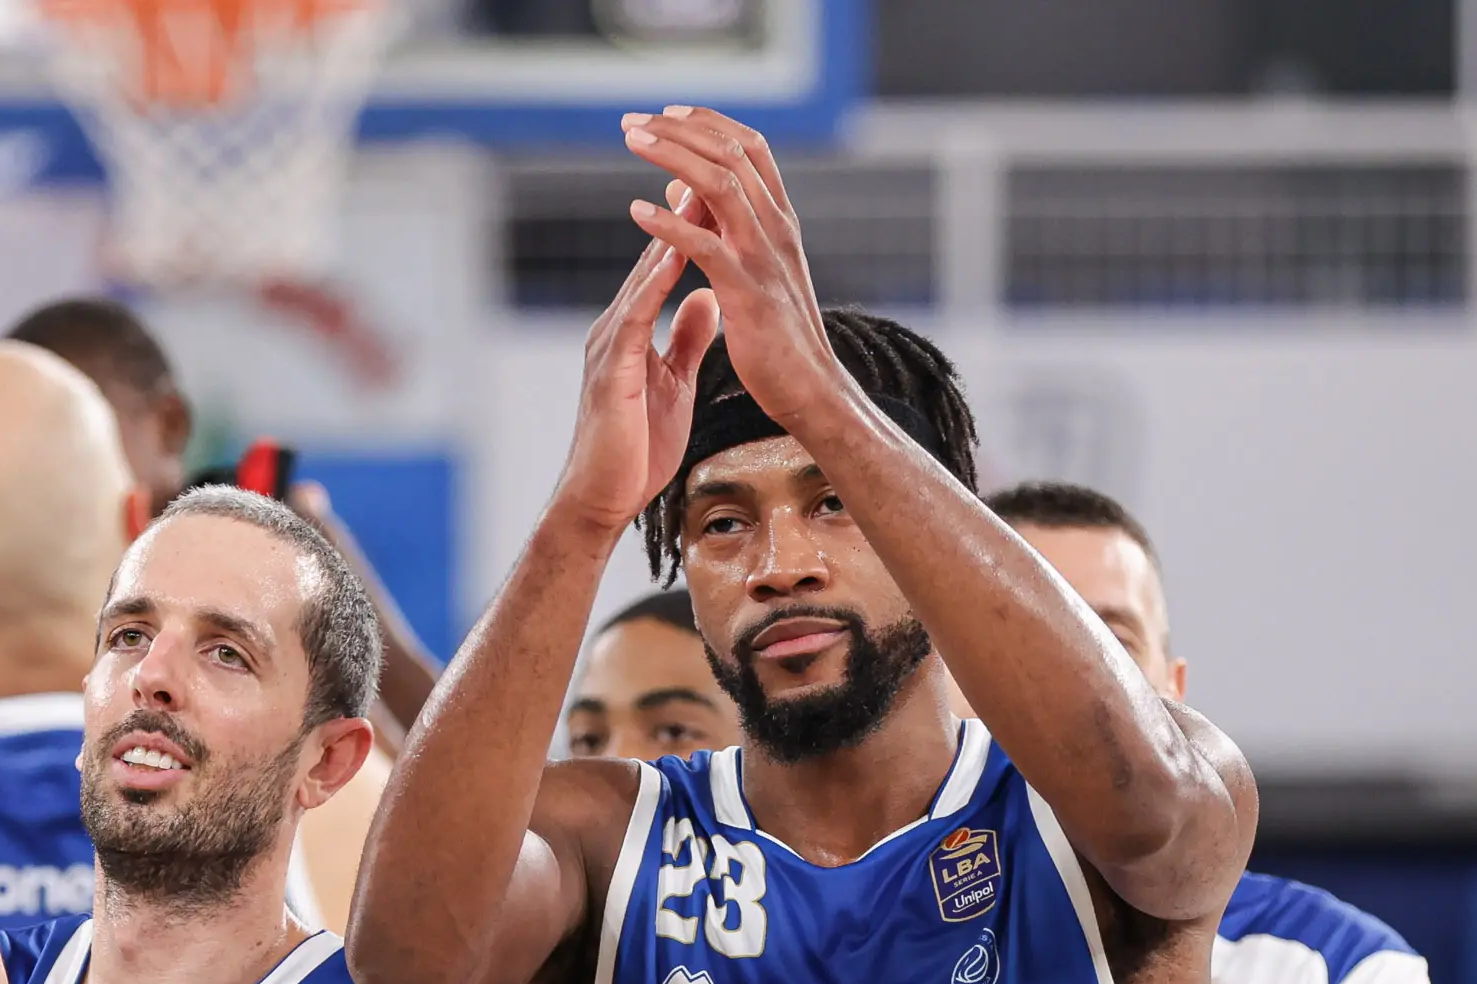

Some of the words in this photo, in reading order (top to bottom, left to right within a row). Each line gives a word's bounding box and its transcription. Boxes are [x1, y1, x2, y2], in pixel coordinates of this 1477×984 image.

[942, 852, 991, 884] LBA
[953, 873, 976, 888] SERIE
[656, 816, 767, 959] 23
[954, 881, 994, 909] Unipol
